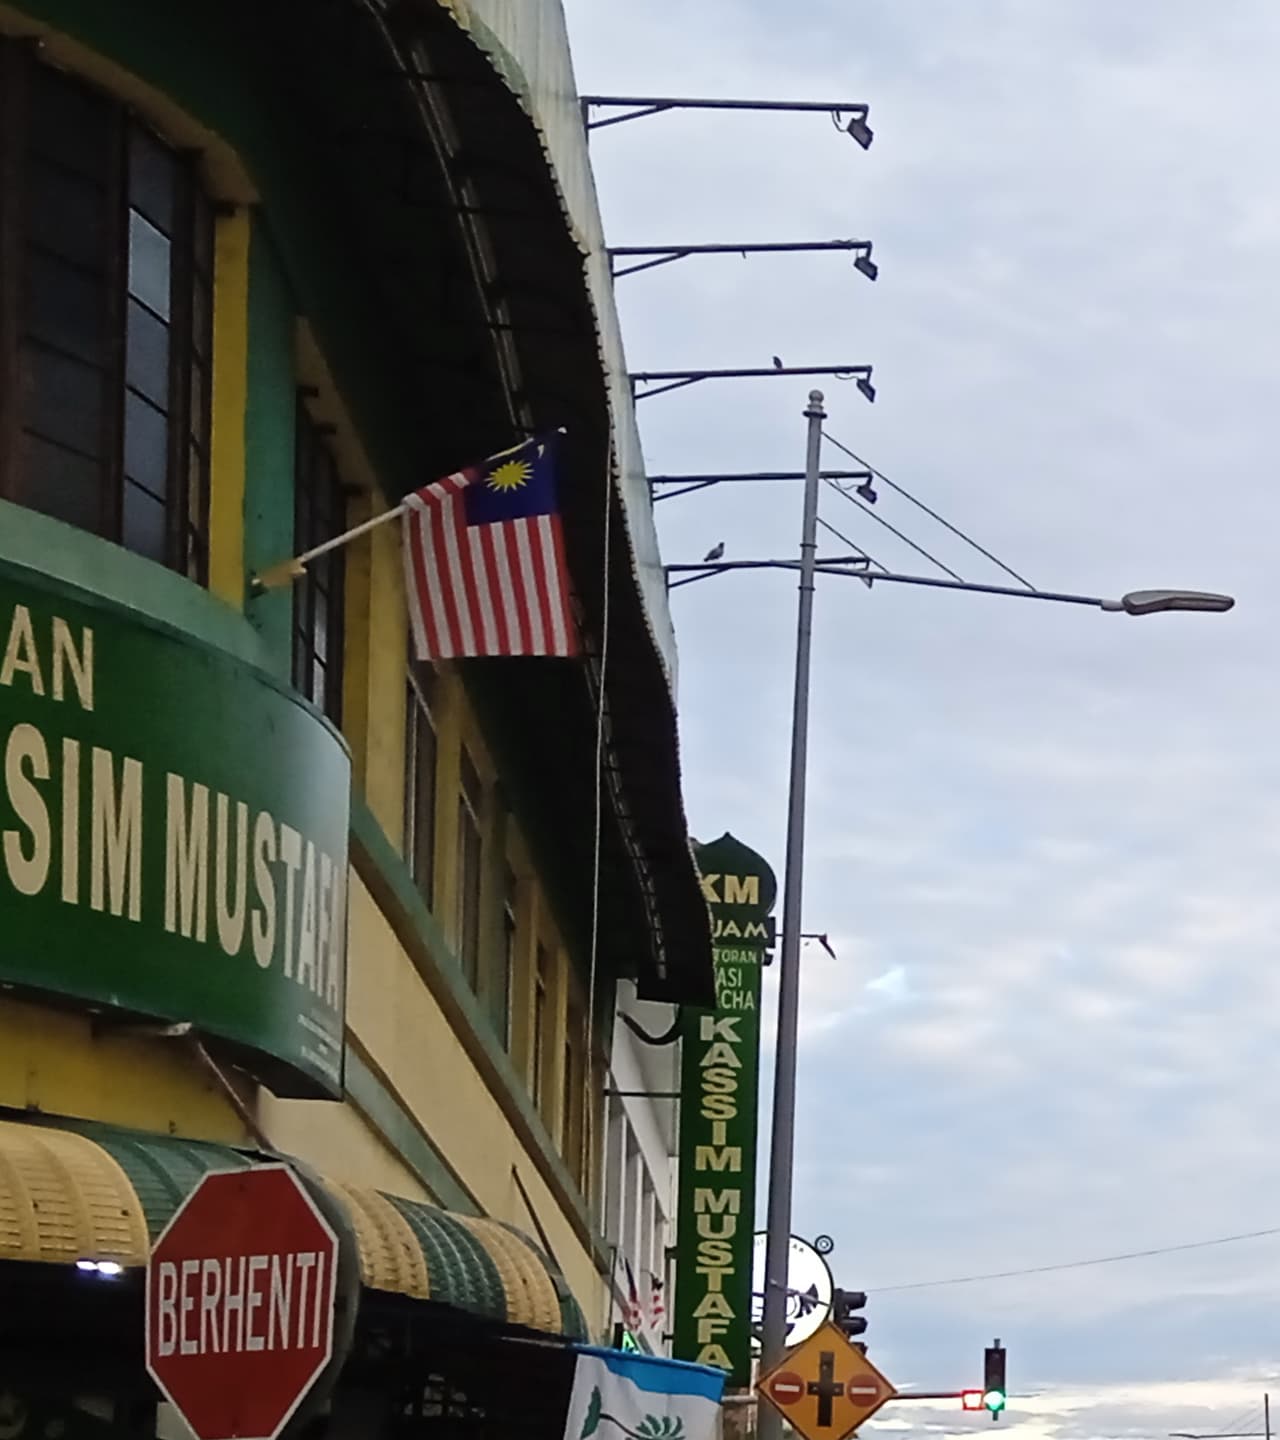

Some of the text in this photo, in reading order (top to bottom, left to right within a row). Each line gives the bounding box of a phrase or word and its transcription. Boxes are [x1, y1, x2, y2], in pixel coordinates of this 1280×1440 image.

[0, 604, 94, 711] AN
[2, 723, 339, 1011] SIM MUSTAFA
[701, 874, 759, 904] KM
[692, 1016, 742, 1369] KASSIM MUSTAFA
[157, 1250, 326, 1357] BERHENTI
